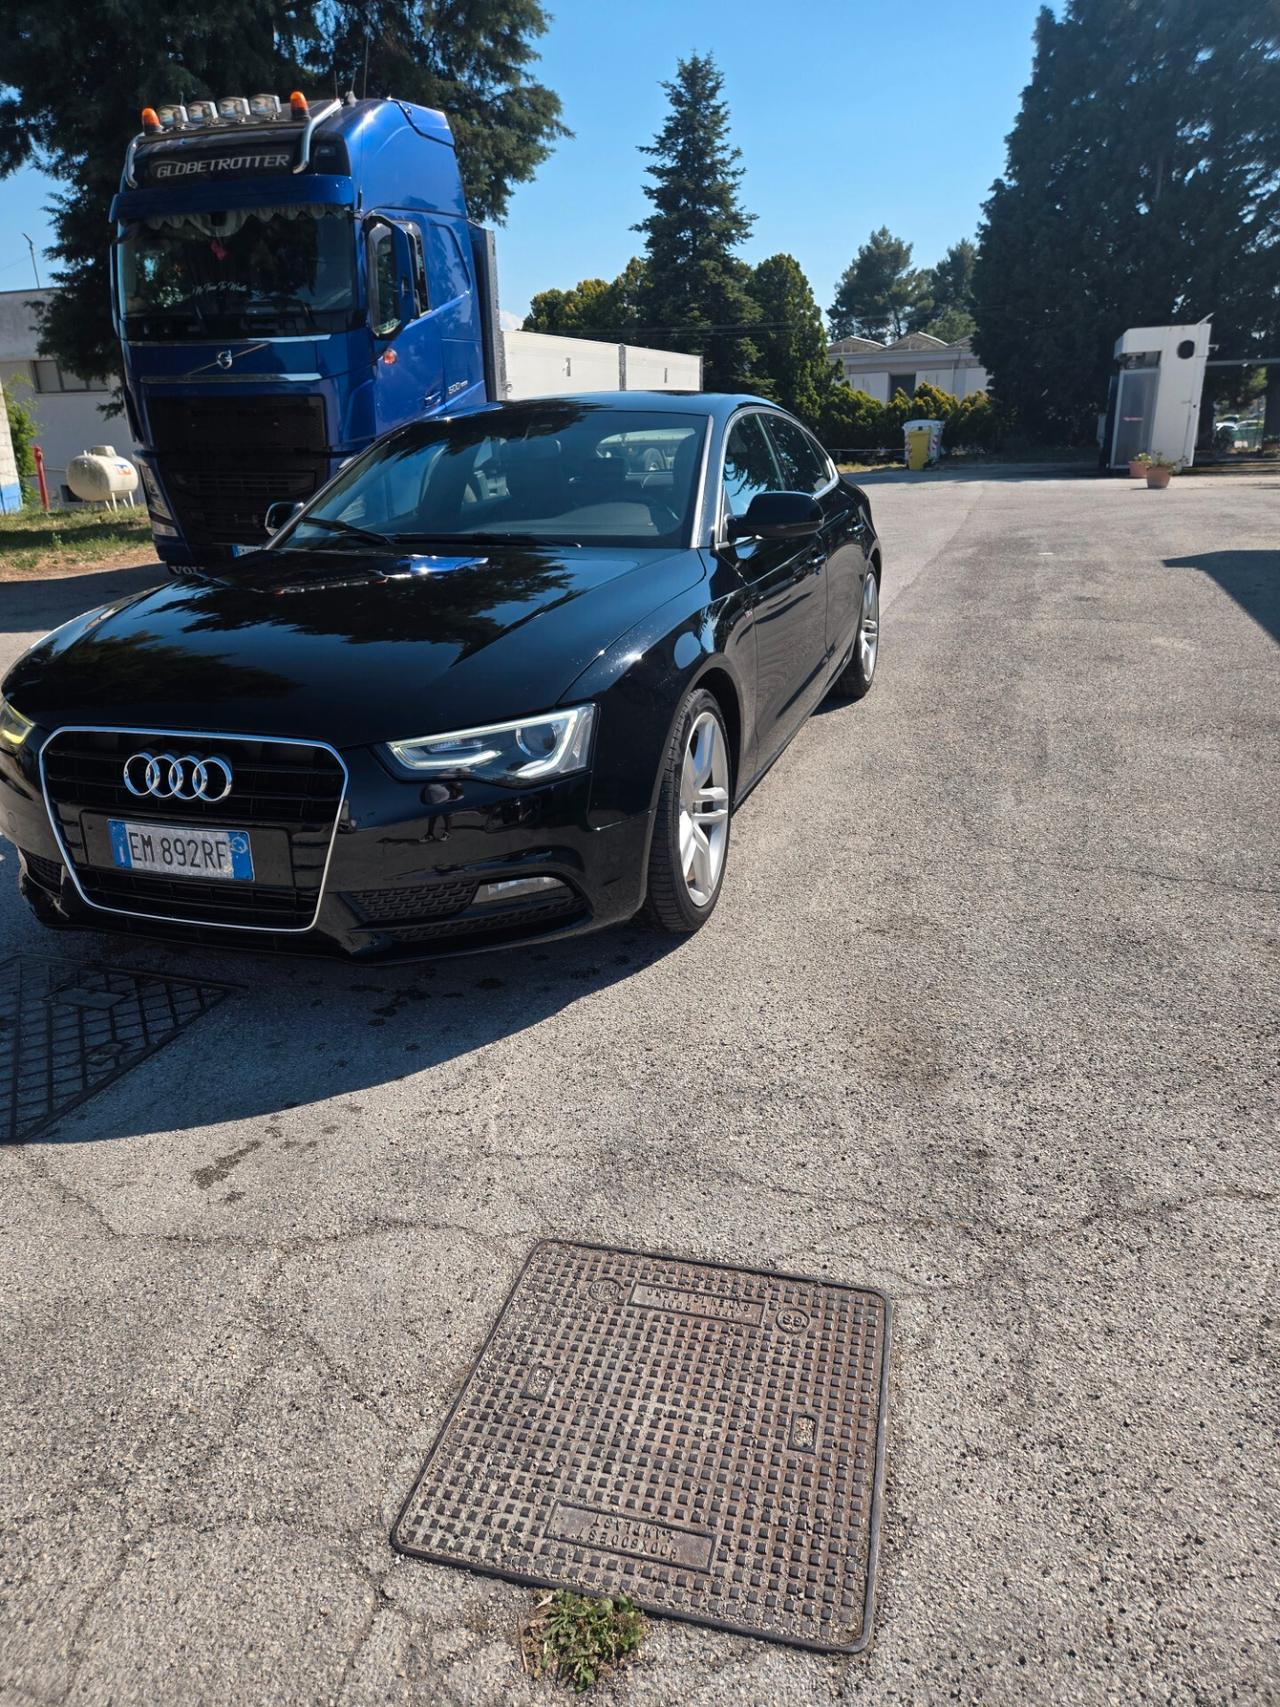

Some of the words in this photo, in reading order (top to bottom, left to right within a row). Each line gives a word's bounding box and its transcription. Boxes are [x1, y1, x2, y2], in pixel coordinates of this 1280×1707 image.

[156, 154, 290, 178] GLOBETROTTER
[128, 831, 155, 863] EM
[160, 837, 227, 869] 892RF
